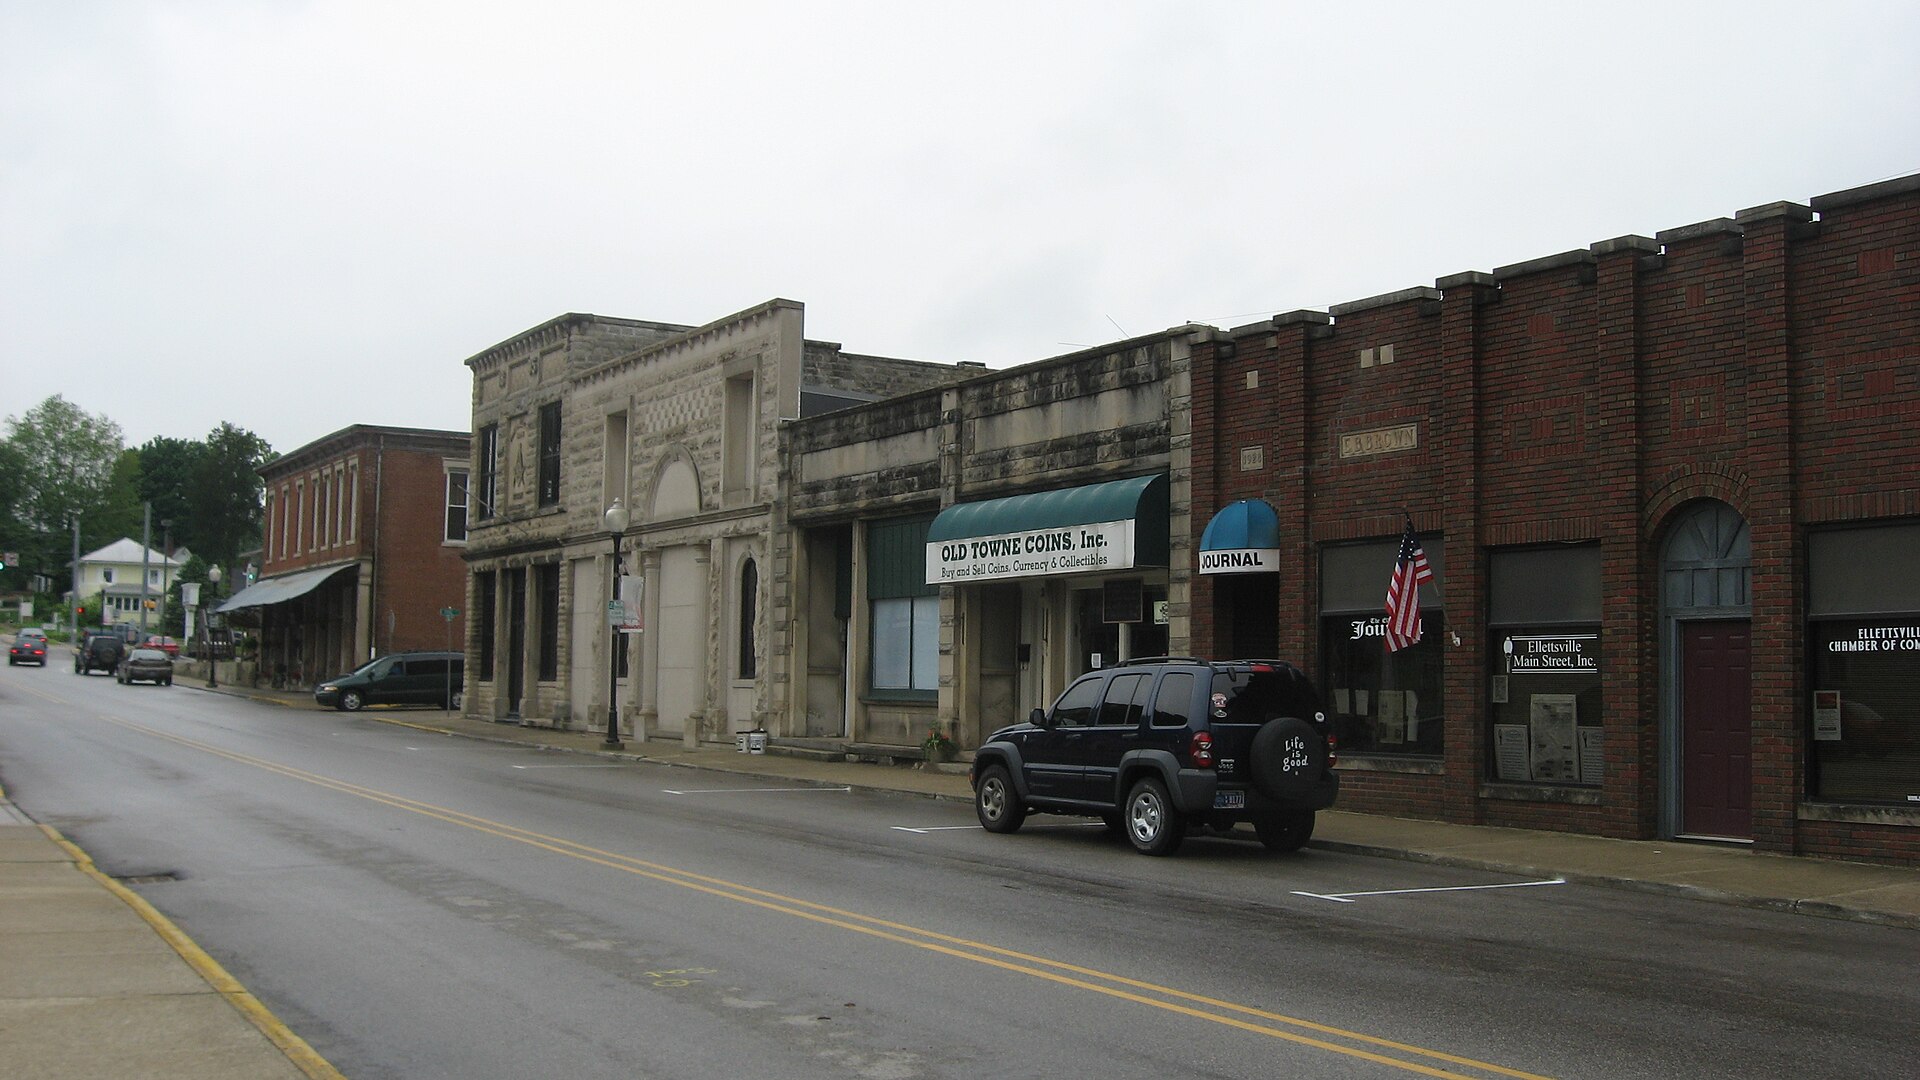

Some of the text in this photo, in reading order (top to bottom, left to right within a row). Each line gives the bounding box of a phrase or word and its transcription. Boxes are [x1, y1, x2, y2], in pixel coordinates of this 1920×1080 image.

[941, 530, 1108, 562] OLD TOWNE COINS, Inc.
[941, 567, 955, 579] Buy
[956, 565, 970, 577] and
[972, 563, 986, 575] Sell
[1013, 559, 1049, 573] Currency
[1051, 557, 1057, 569] &
[1059, 552, 1108, 568] Collectibles
[1201, 552, 1263, 569] JOURNAL
[1528, 640, 1582, 653] Ellettsville
[1828, 640, 1878, 652] CHAMBER
[1881, 639, 1896, 651] OF
[1513, 654, 1596, 668] Main Street, Inc.
[1285, 736, 1304, 751] Life
[1291, 750, 1300, 758] is
[1282, 755, 1308, 771] good
